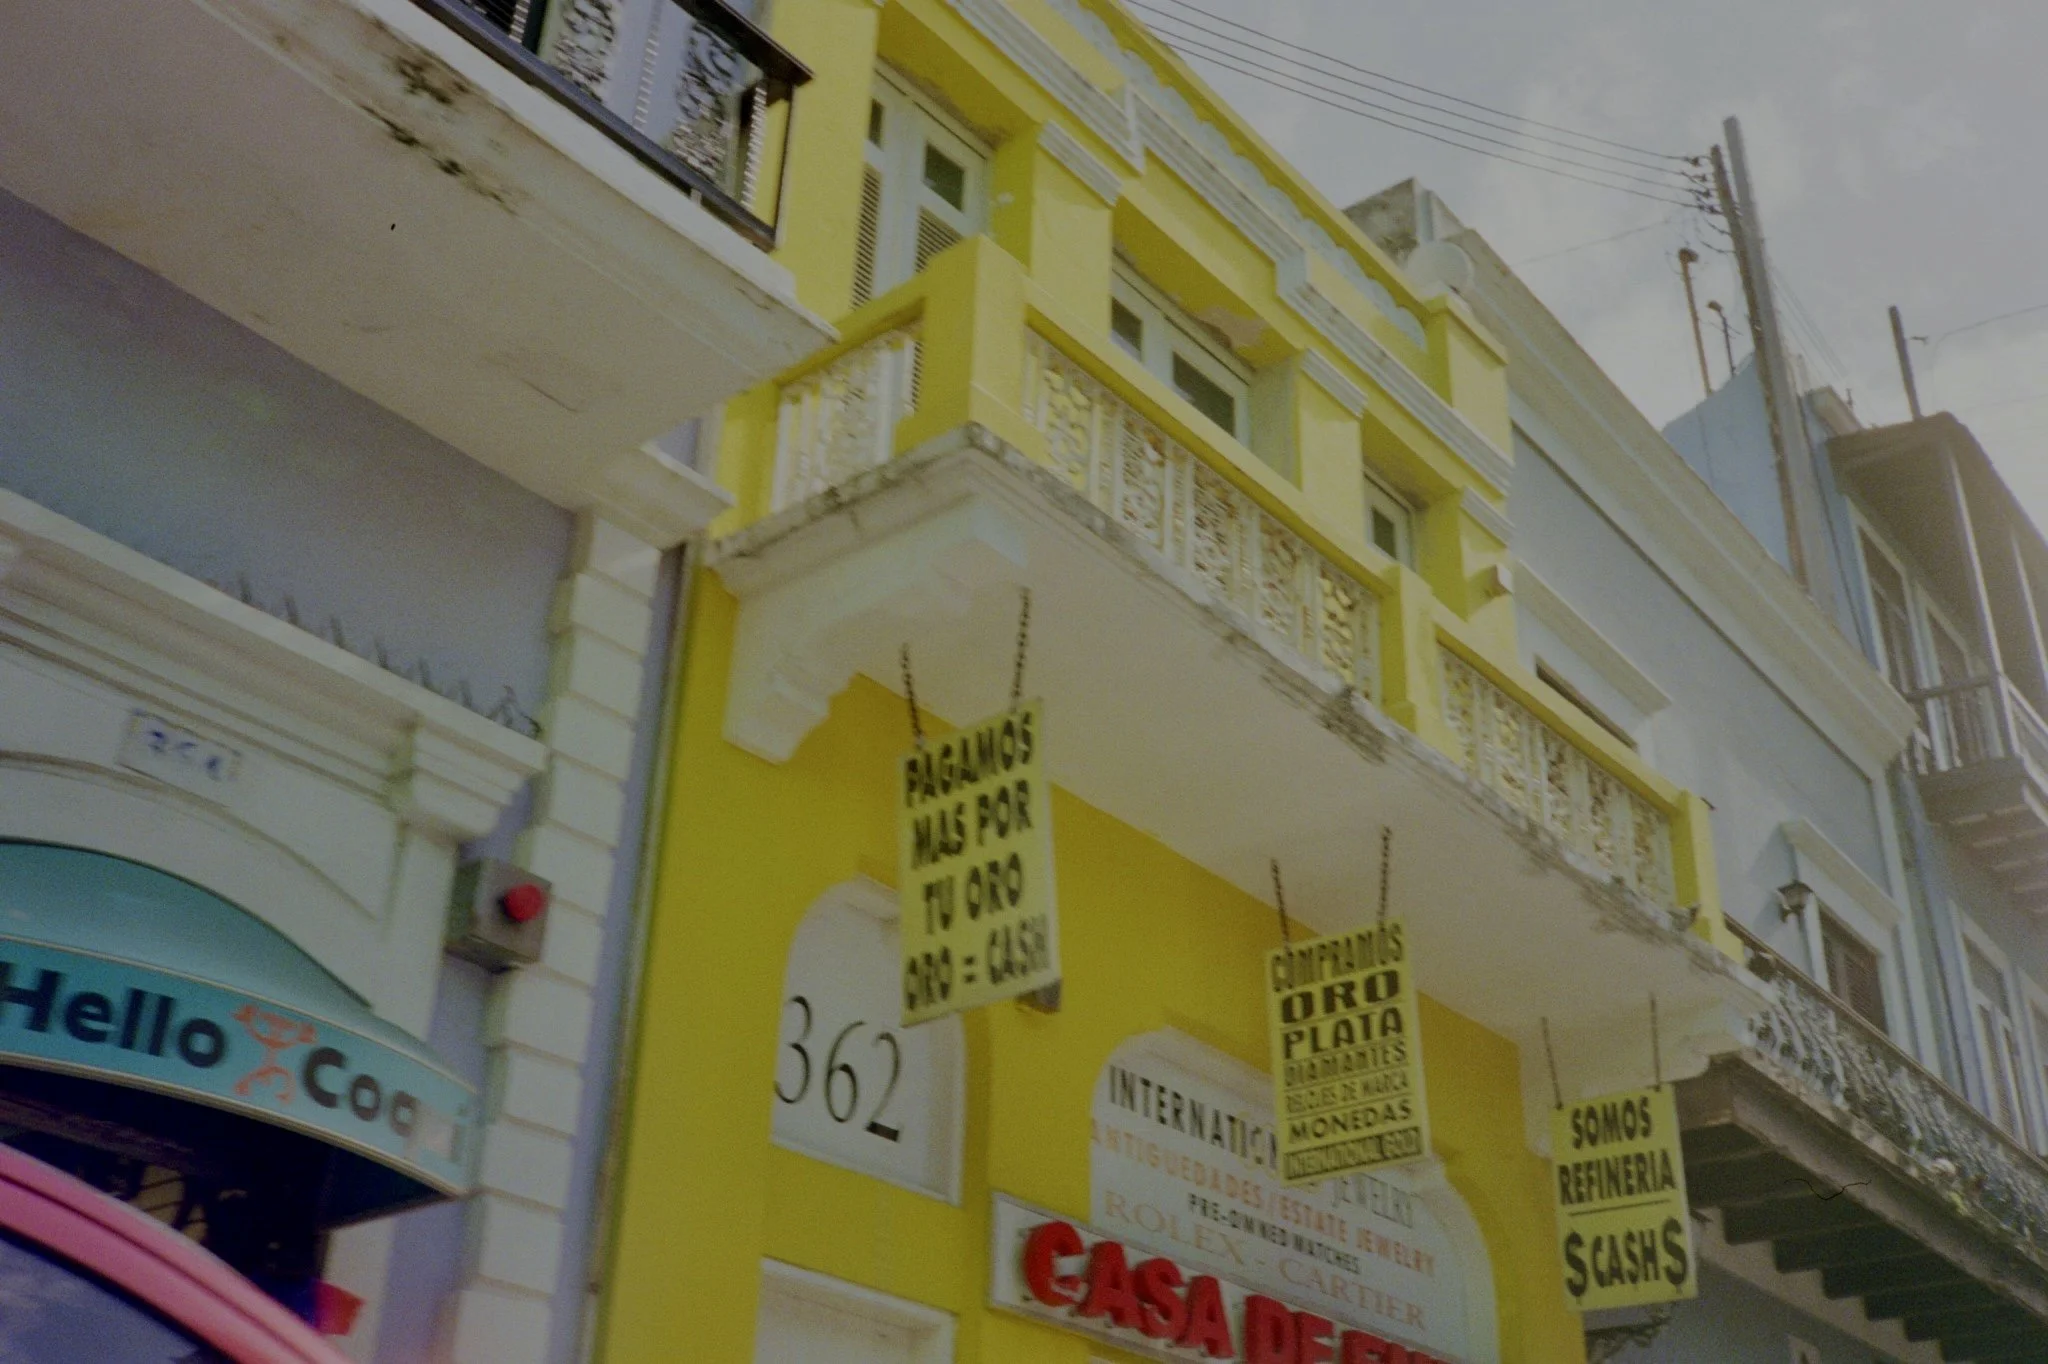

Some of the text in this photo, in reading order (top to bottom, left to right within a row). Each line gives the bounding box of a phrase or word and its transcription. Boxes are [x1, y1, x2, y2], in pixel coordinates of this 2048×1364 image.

[905, 711, 1033, 807] PAGAMOS
[911, 780, 1033, 869] MAS POR
[924, 852, 1023, 935] TU ORO
[0, 961, 227, 1068] Hello
[905, 946, 953, 1011] ORO
[1281, 970, 1399, 1024] ORO
[774, 995, 902, 1143] 362
[1283, 1006, 1404, 1060] PLATA
[1288, 1099, 1413, 1144] MONEDAS
[1571, 1096, 1651, 1150] SOMOS
[1557, 1148, 1677, 1205] REFINERIA
[1022, 1220, 1234, 1358] CASA
[1103, 1191, 1246, 1265] ROLEX
[1279, 1257, 1427, 1331] CARTIER
